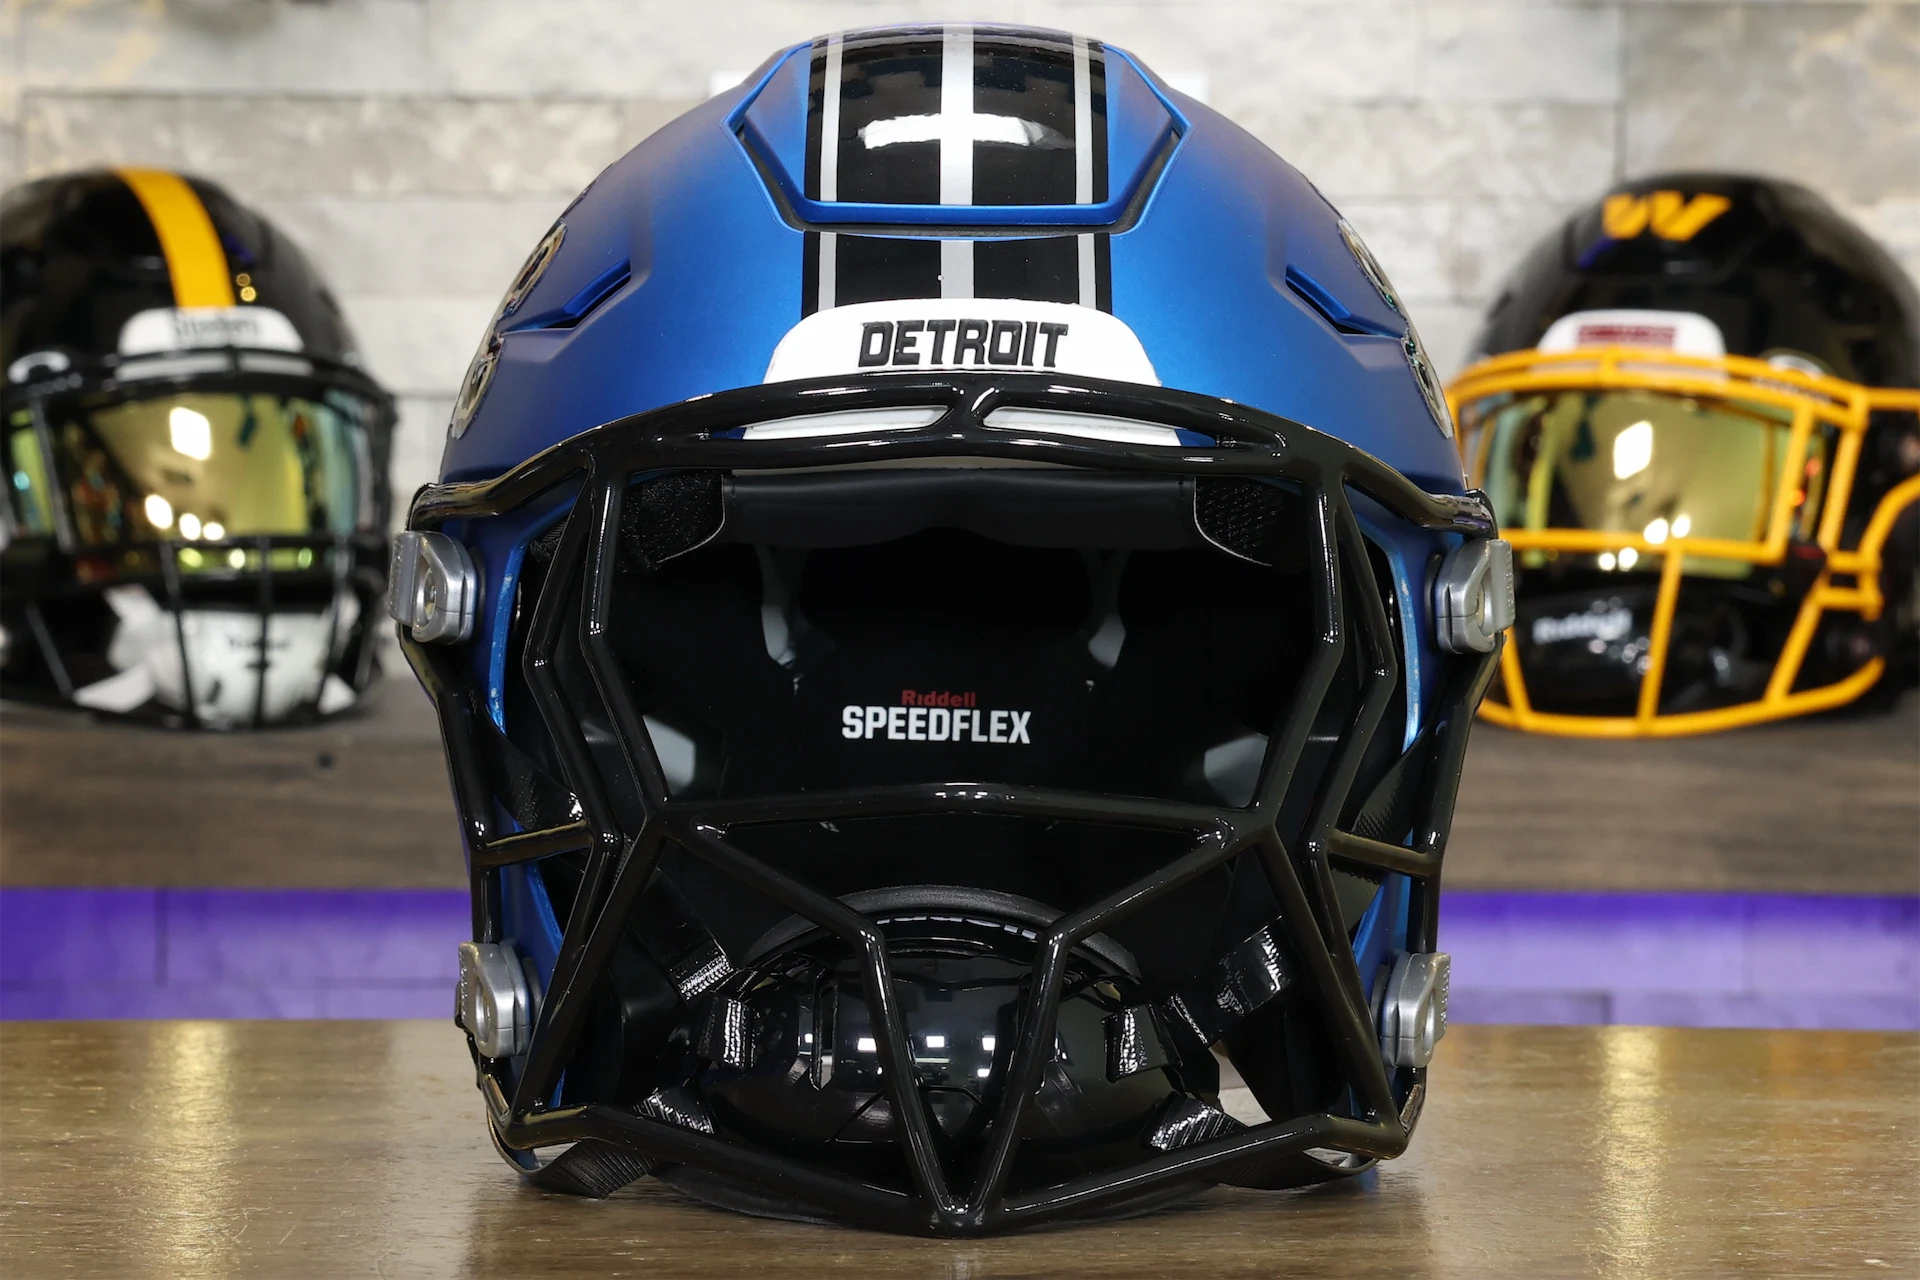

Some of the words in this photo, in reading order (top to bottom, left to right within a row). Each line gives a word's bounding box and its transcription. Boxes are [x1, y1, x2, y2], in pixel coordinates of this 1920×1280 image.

[858, 318, 1069, 368] DETROIT
[901, 689, 976, 708] Riddell
[842, 705, 1032, 744] SPEEDFLEX
